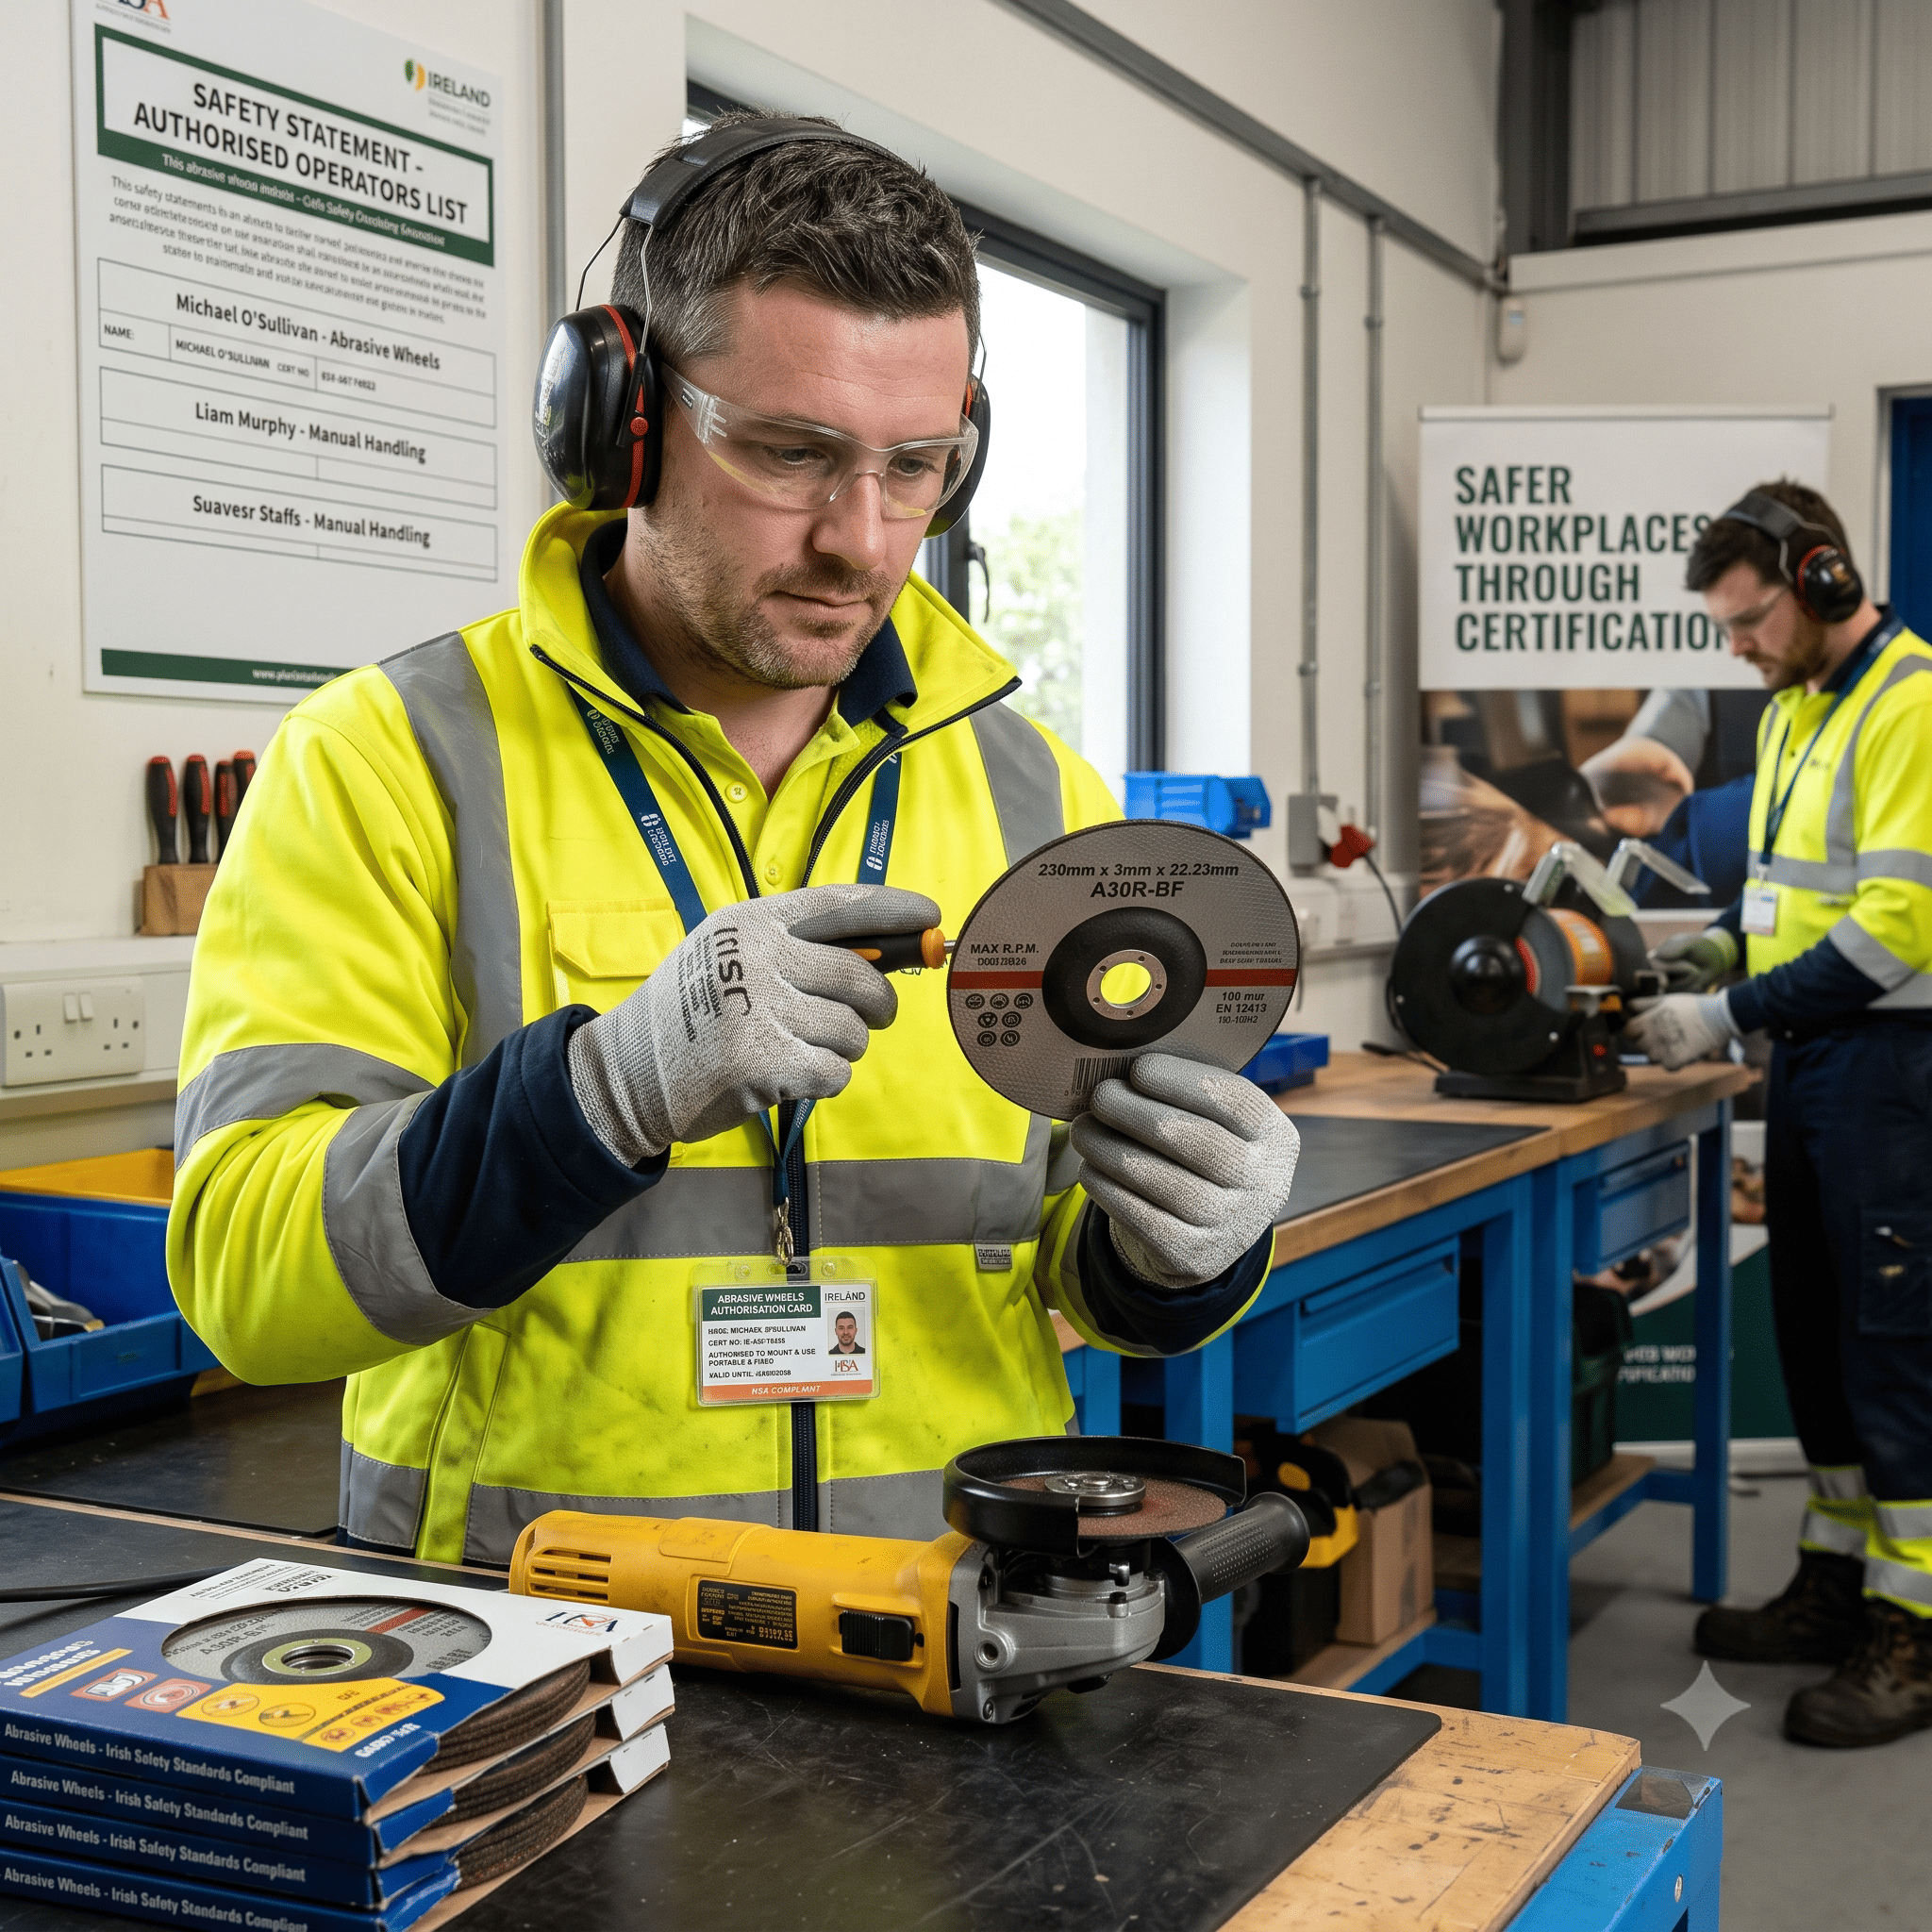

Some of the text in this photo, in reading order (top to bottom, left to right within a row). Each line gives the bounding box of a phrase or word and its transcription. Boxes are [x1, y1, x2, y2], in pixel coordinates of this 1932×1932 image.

[428, 71, 491, 108] IRELAND
[192, 83, 279, 131] SAFETY
[287, 113, 410, 174] STATEMENT
[134, 102, 468, 225] AUTHORISED OPERATORS LIST
[104, 324, 135, 340] NAME:
[175, 340, 216, 358] MICHAEL
[176, 293, 238, 324] Michael
[242, 309, 318, 341] O'Sullivan
[330, 330, 390, 358] Abrasive
[393, 344, 441, 370] Wheels
[195, 402, 234, 425] Liam
[239, 410, 296, 441] Murphy
[309, 424, 361, 449] Manual
[365, 434, 426, 464] Handling
[1455, 466, 1573, 506] SAFER
[193, 495, 256, 520] Suavesr
[259, 505, 301, 527] Staffs
[314, 513, 366, 536] Manual
[369, 522, 430, 549] Handling
[1455, 563, 1641, 602] THROUGH
[1038, 863, 1240, 876] 230mm x 3mm x 22.23mm
[1091, 881, 1185, 898] A30R-BF
[970, 943, 1040, 954] MAX R.P.M.
[1216, 1004, 1267, 1013] EN 12413
[1223, 991, 1241, 1001] 100
[710, 1304, 813, 1315] AUTHORISATION CARD
[718, 1293, 764, 1304] ABRASIVE
[752, 1387, 769, 1395] HSA
[5, 1723, 52, 1745] Abrasive
[106, 1743, 131, 1761] Irish
[173, 1757, 232, 1782] Standards
[234, 1769, 295, 1794] Compliant
[11, 1770, 59, 1792] Abrasive
[62, 1779, 105, 1801] Wheels
[115, 1790, 142, 1807] Irish
[144, 1795, 181, 1818] Safety
[184, 1803, 244, 1828] Standards
[246, 1815, 309, 1840] Compliant
[5, 1814, 54, 1837] Abrasive
[57, 1824, 100, 1845] Wheels
[110, 1834, 136, 1852] Irish
[139, 1839, 176, 1862] Safety
[179, 1846, 240, 1871] Standards
[242, 1857, 307, 1883] Compliant
[4, 1867, 55, 1890] Abrasive
[58, 1876, 101, 1898] Wheels
[111, 1887, 138, 1906] Irish
[141, 1892, 179, 1916] Safety
